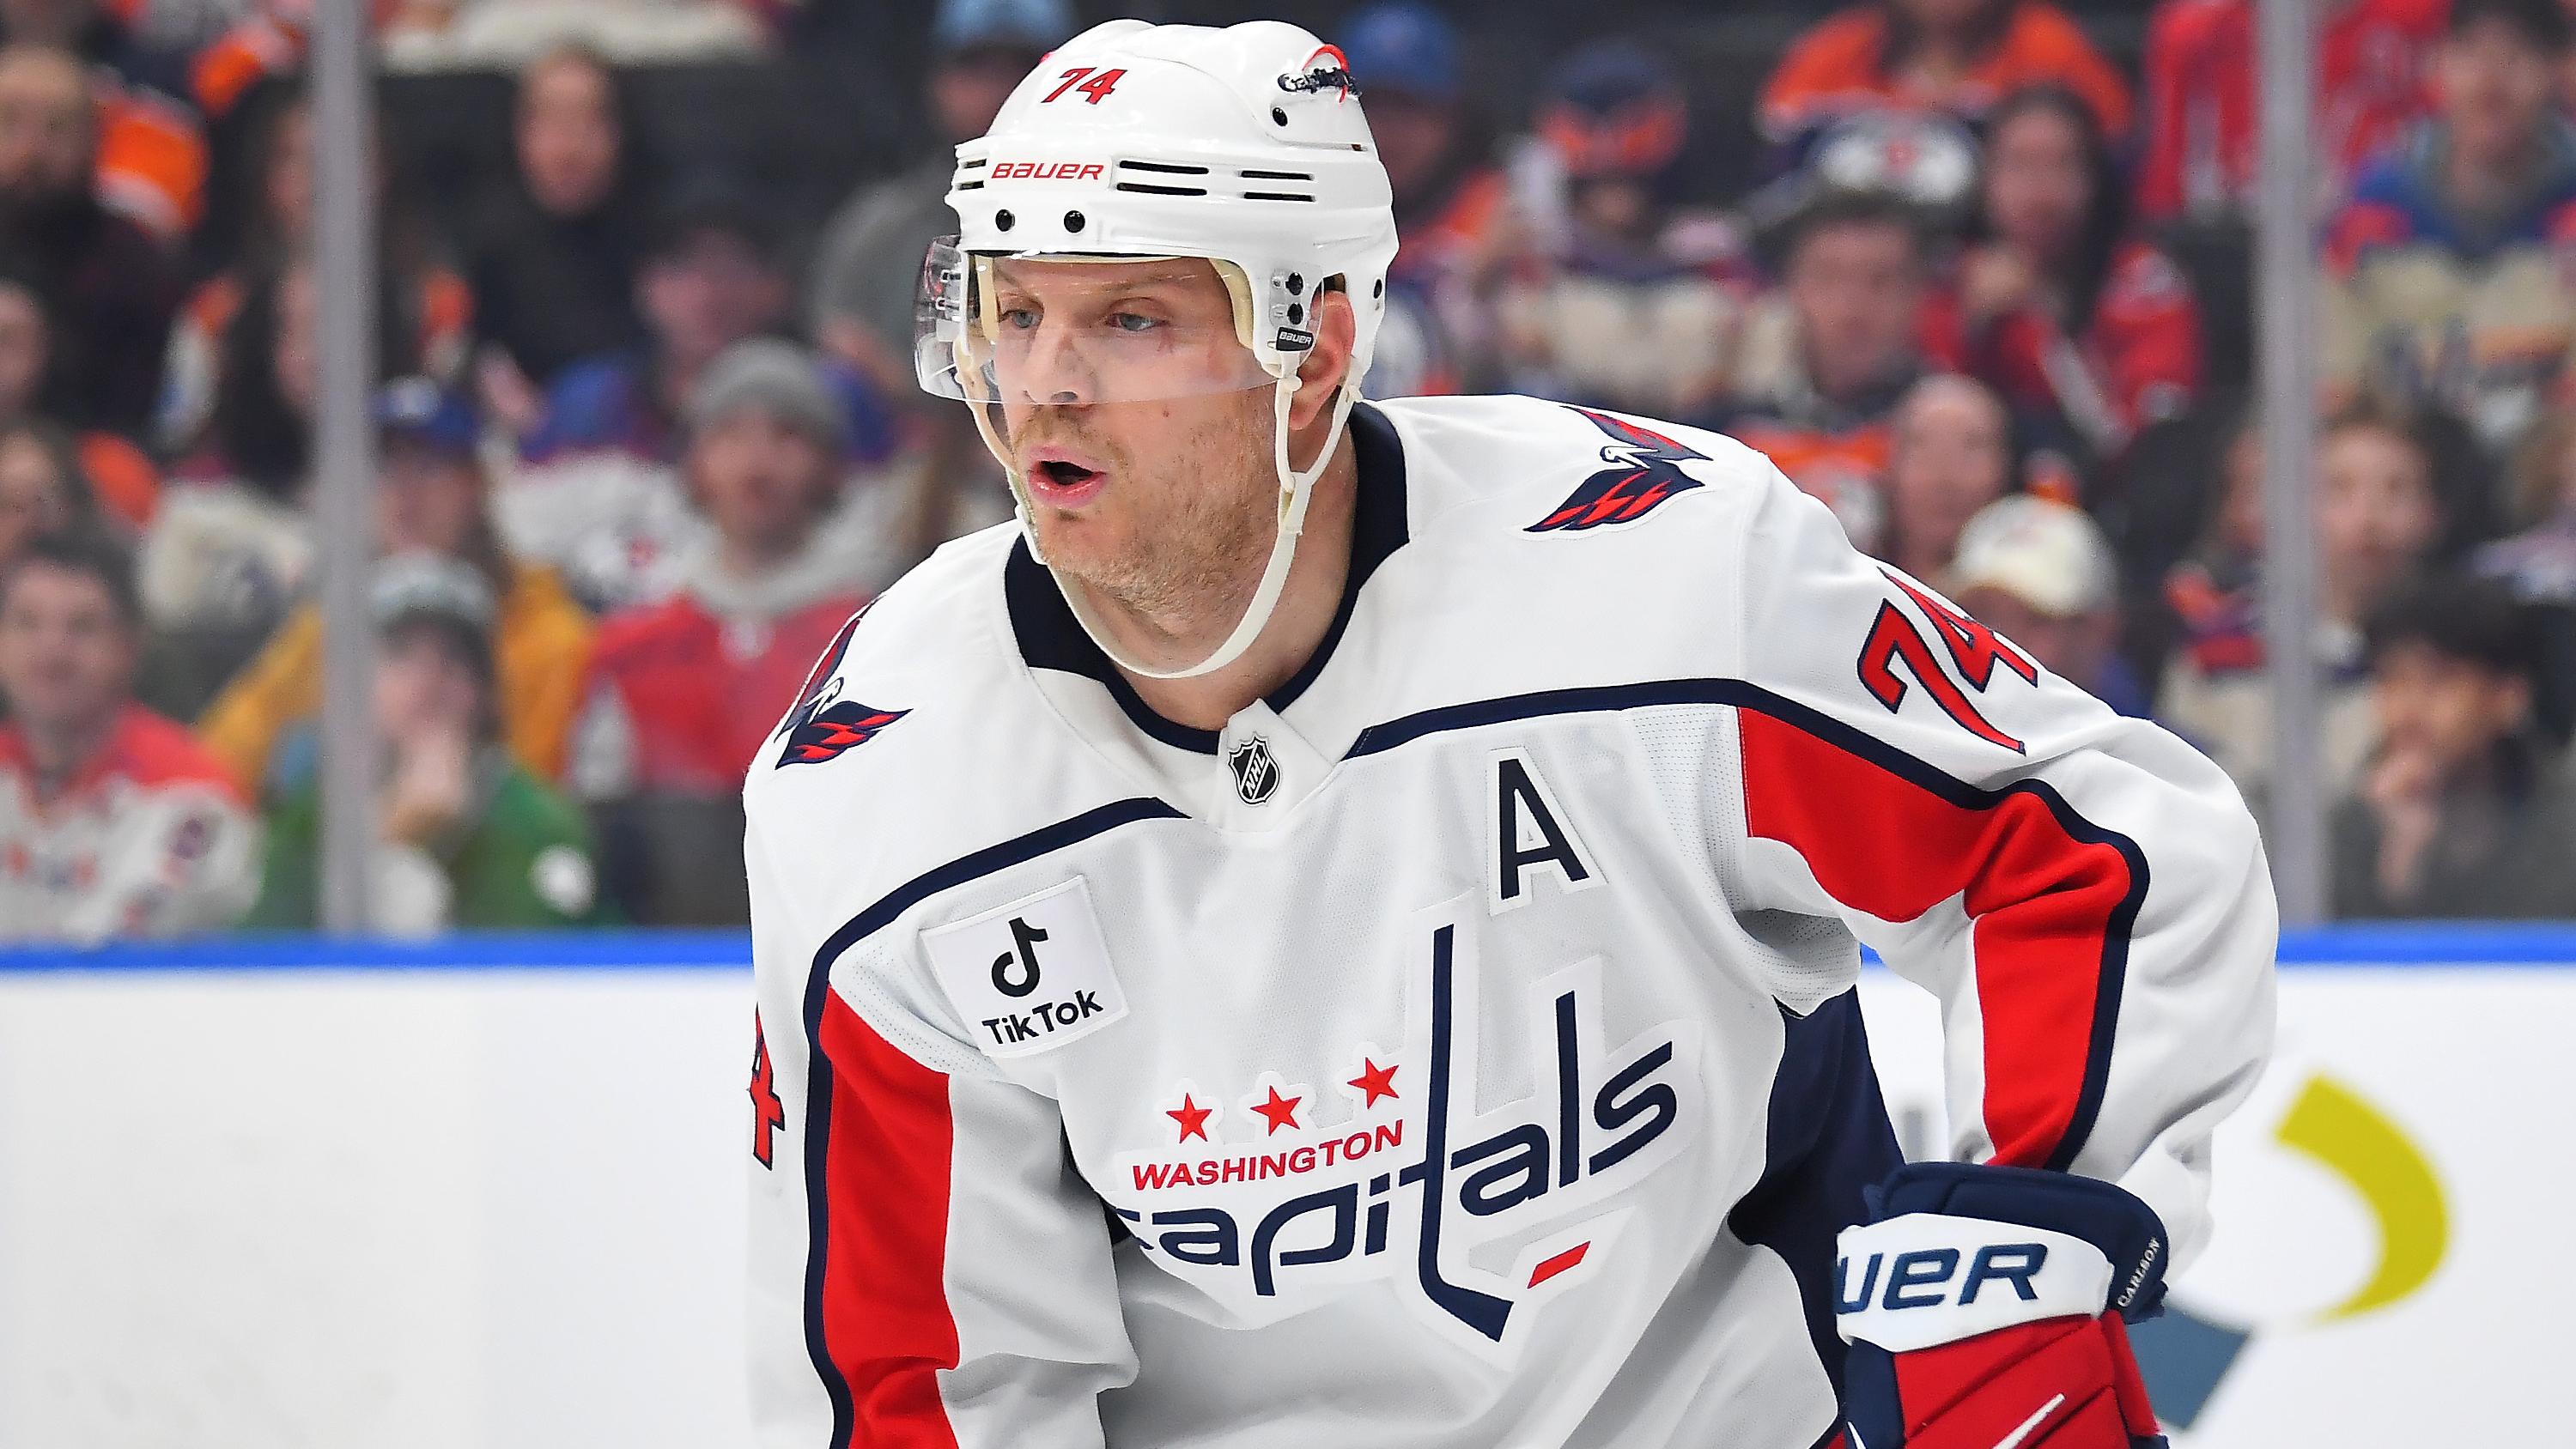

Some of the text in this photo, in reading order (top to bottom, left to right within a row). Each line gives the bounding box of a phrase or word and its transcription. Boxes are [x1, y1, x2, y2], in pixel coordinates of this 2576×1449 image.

[1040, 66, 1128, 105] 74
[991, 162, 1104, 180] BAUER
[1856, 566, 2038, 756] 74
[1245, 752, 1266, 797] NHL
[1498, 758, 1590, 900] A
[981, 990, 1103, 1044] TikTok
[1133, 1119, 1403, 1191] WASHINGTON
[2117, 1236, 2160, 1307] CARLSON
